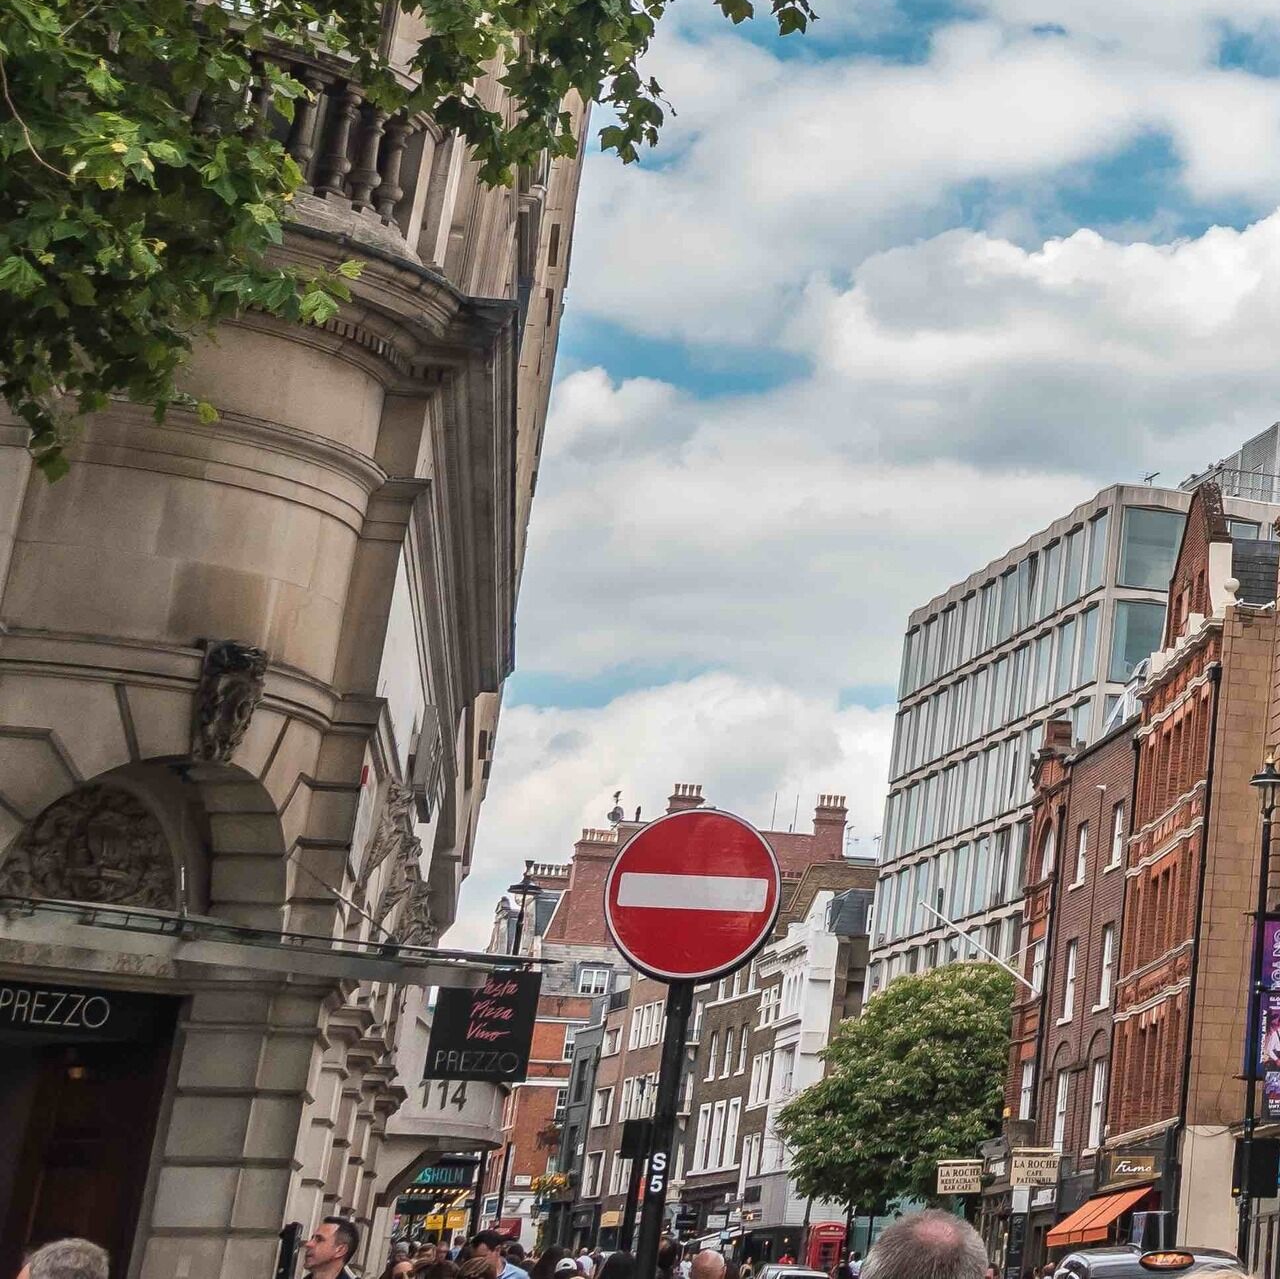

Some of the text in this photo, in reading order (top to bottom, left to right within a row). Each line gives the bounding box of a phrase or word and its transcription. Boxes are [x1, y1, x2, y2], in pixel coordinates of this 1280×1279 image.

[0, 988, 110, 1028] PREZZO
[470, 1000, 515, 1020] Pizza
[466, 1021, 511, 1041] Vino
[434, 1050, 519, 1073] PREZZO
[418, 1080, 468, 1112] 114
[651, 1152, 667, 1171] S
[1014, 1159, 1058, 1169] LA ROCHE
[940, 1168, 980, 1177] LA ROCHE
[941, 1177, 981, 1185] RESTAURANT
[650, 1175, 663, 1193] 5
